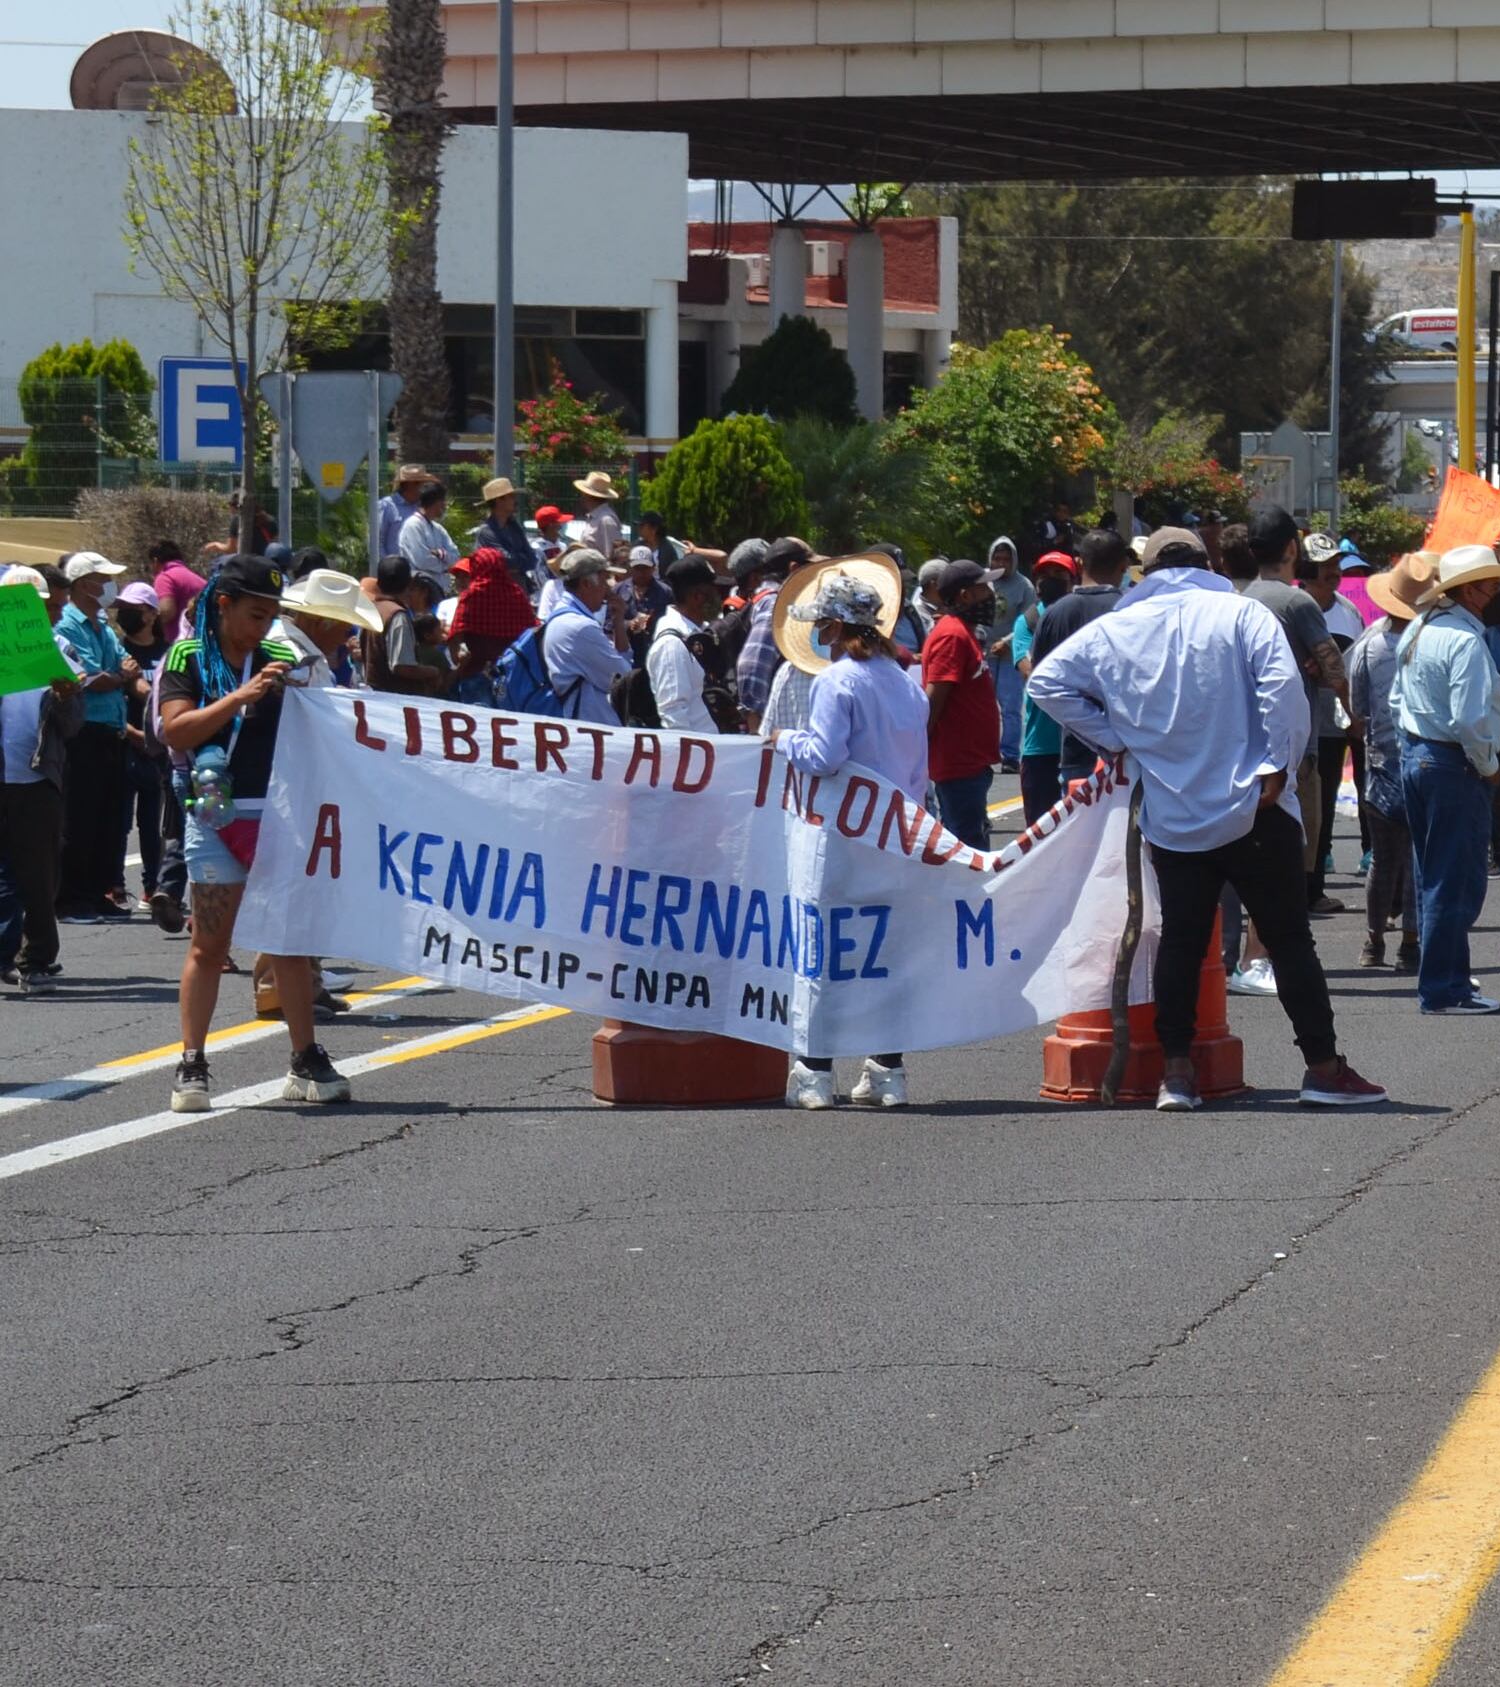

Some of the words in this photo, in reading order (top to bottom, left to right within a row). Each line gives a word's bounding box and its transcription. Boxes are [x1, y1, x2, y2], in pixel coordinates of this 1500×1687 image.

[178, 368, 236, 463] E
[353, 700, 715, 793] LIBERTAD
[305, 803, 342, 880] A
[378, 823, 547, 929] KENIA
[580, 863, 892, 981] HERNANDEZ
[955, 897, 1022, 970] M.
[423, 926, 711, 1009] MASCIP-CNPA
[739, 982, 789, 1026] MN
